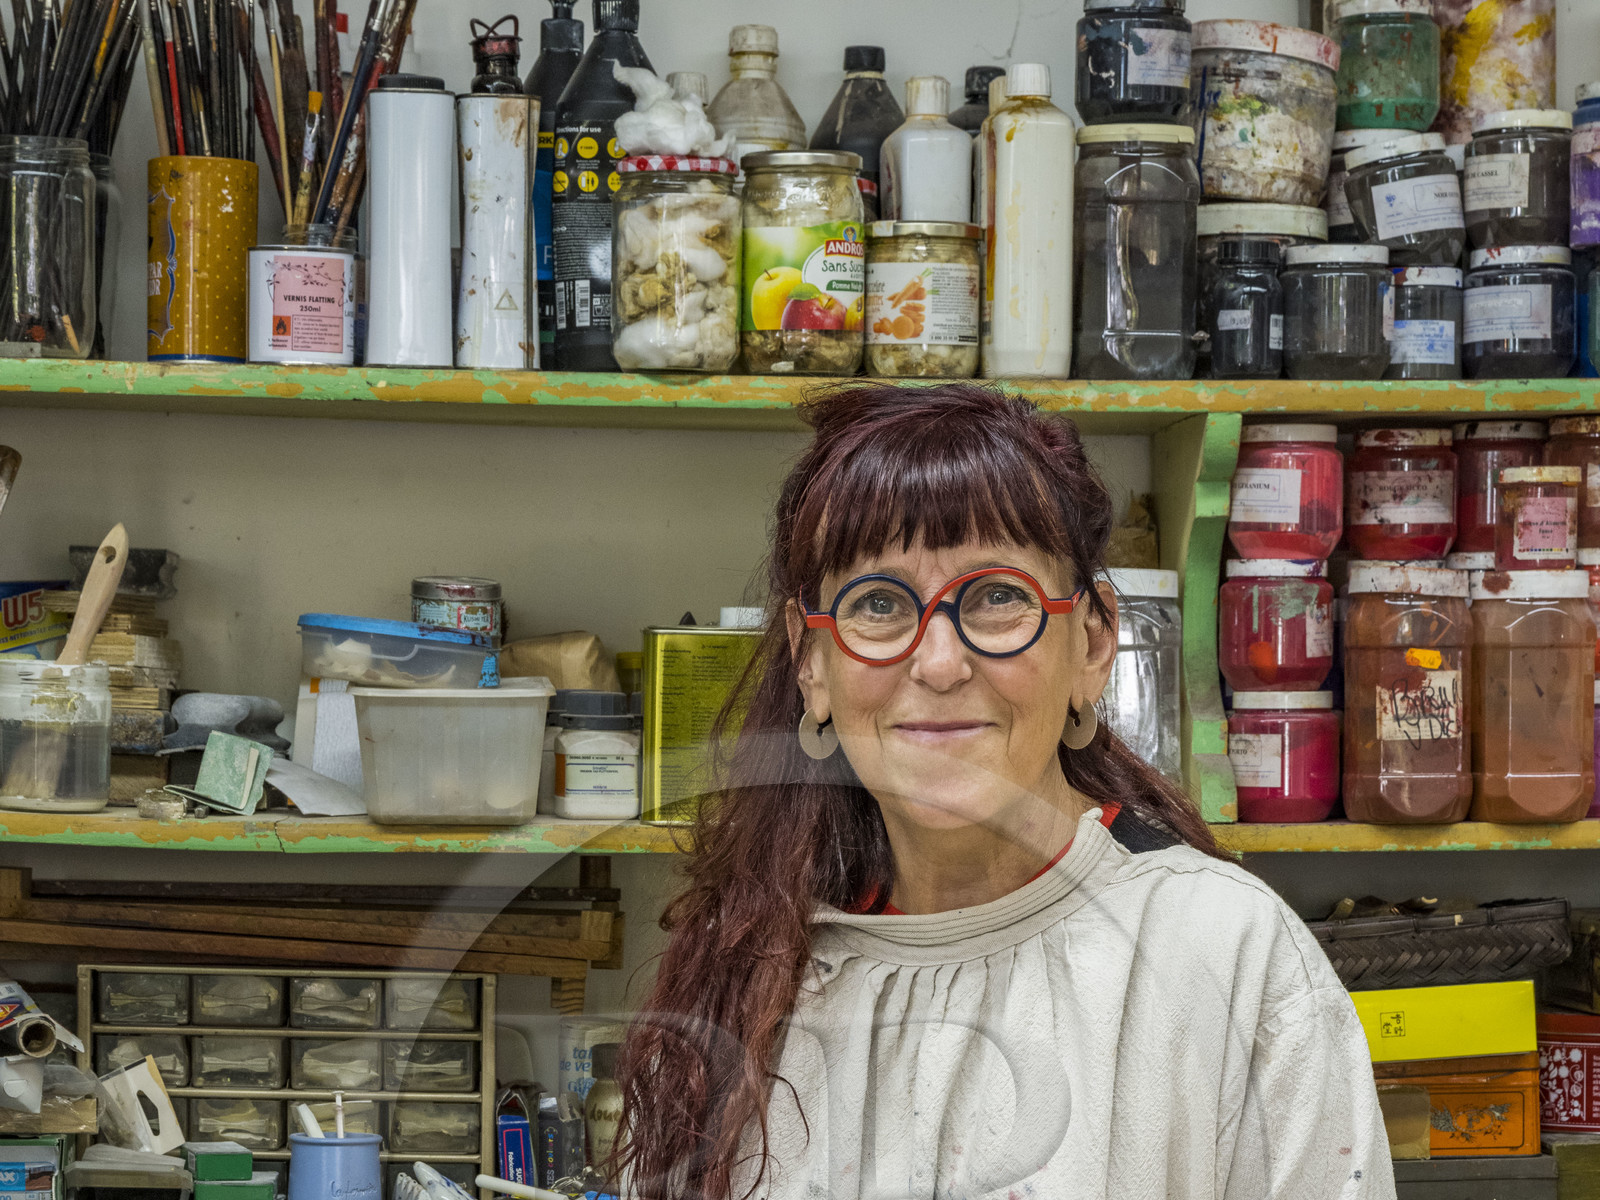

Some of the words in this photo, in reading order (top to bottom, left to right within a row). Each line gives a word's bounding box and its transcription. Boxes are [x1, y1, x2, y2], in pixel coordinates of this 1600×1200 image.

[821, 259, 848, 273] Sans
[283, 294, 307, 303] VERNIS
[308, 295, 336, 304] FLATTING
[299, 304, 321, 312] 250ml
[2, 590, 45, 630] W5
[507, 1151, 515, 1181] Fabrication
